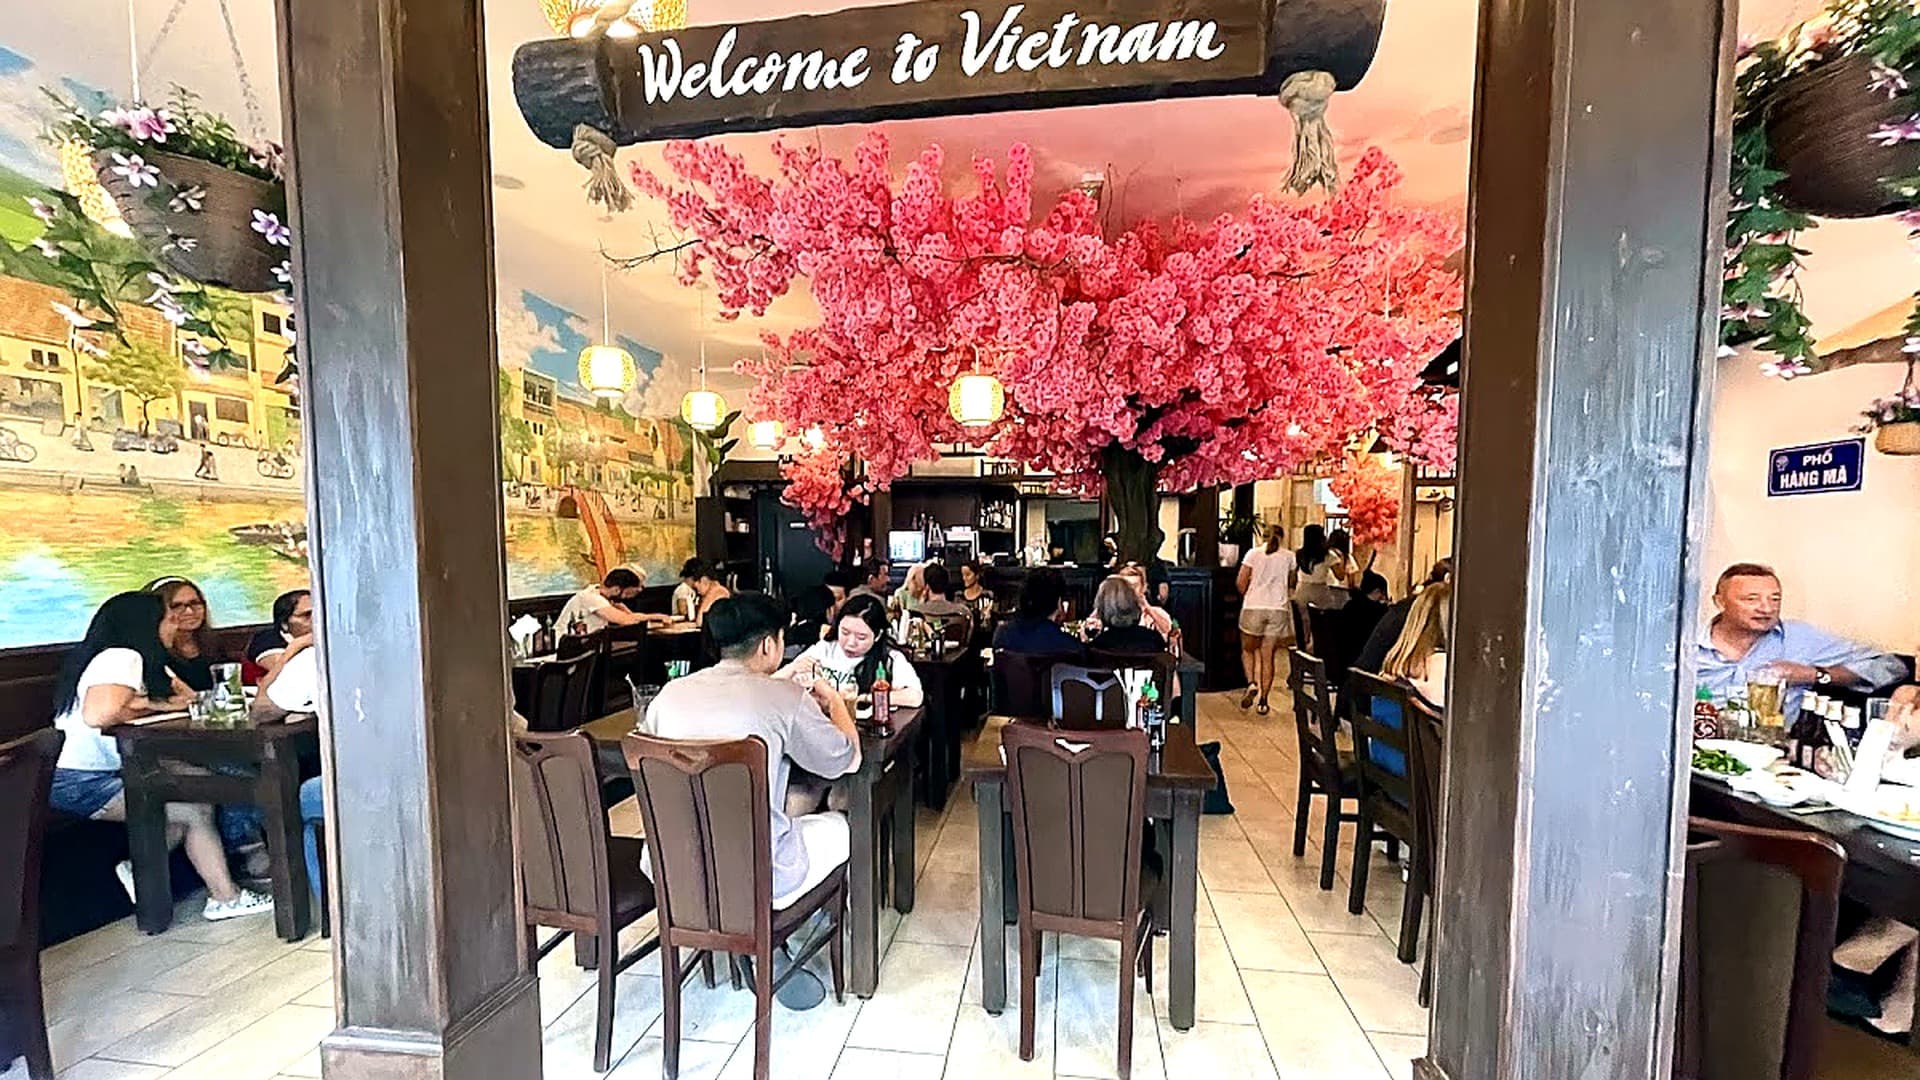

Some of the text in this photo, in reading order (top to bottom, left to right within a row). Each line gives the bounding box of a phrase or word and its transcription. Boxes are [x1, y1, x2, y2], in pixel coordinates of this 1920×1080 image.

[637, 3, 1226, 105] Welcome to Vietnam
